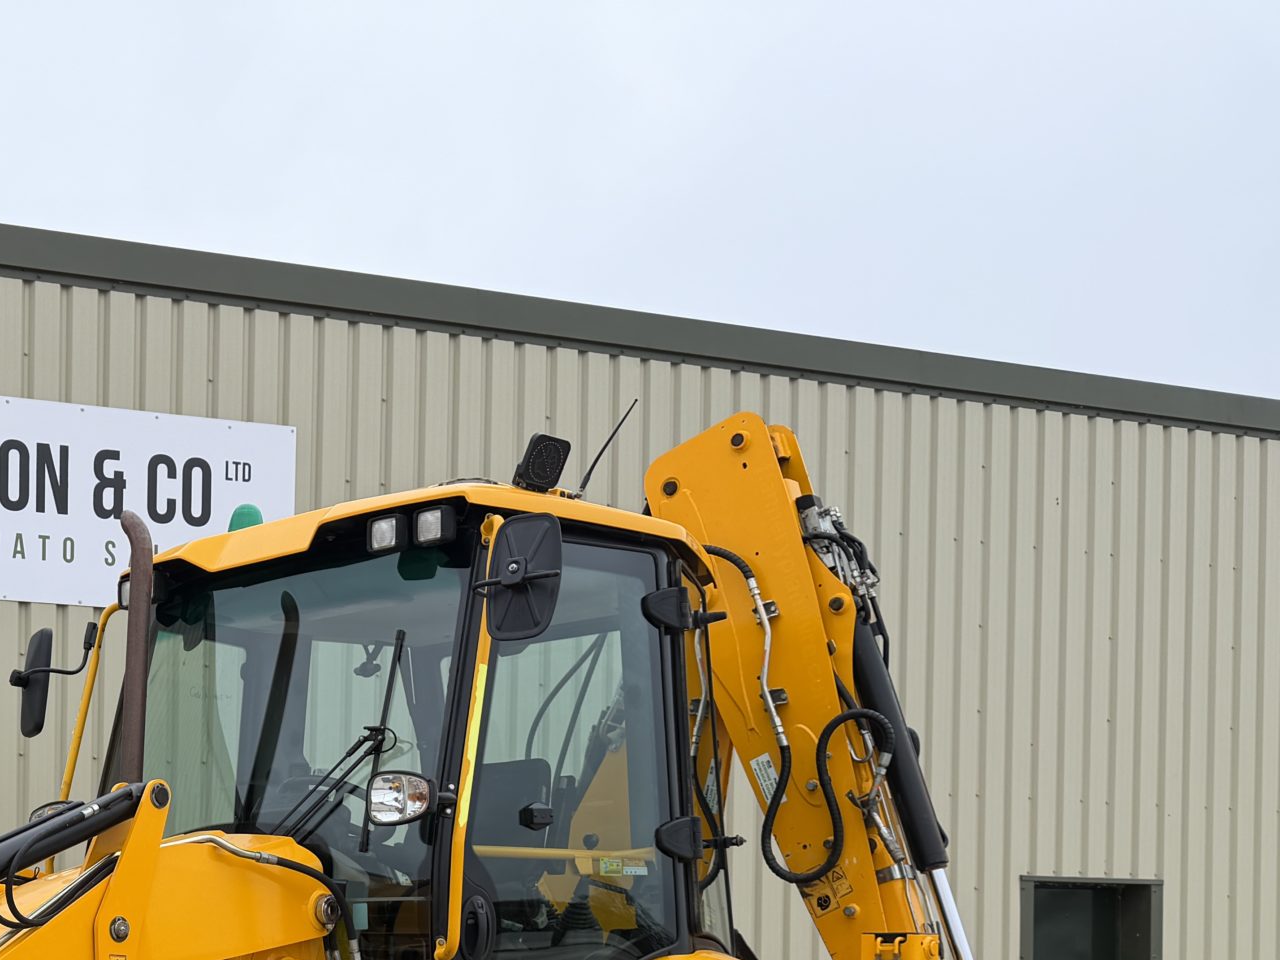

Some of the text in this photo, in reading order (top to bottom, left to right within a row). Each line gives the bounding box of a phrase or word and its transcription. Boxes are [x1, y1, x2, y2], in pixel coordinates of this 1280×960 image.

[92, 448, 128, 520] &
[146, 453, 212, 528] CO
[224, 460, 252, 483] LTD
